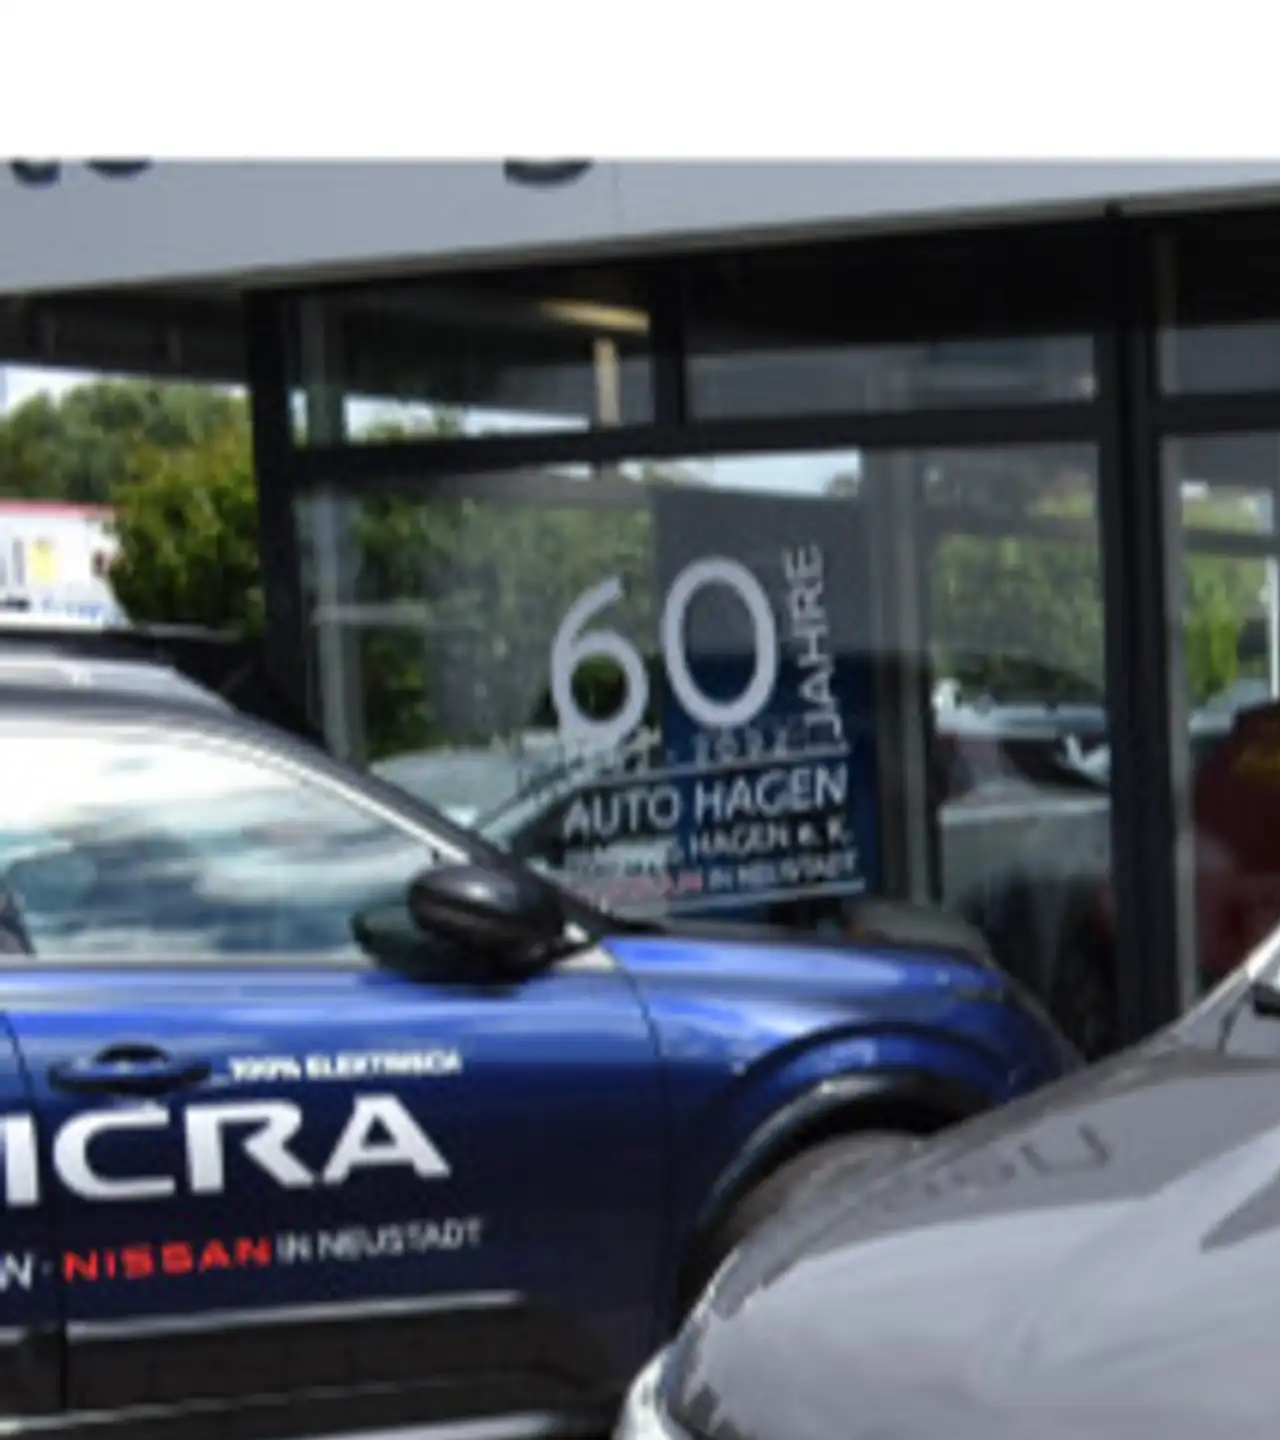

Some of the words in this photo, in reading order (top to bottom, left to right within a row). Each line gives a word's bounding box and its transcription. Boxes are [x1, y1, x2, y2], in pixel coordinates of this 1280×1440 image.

[551, 554, 778, 742] 60
[783, 543, 844, 739] JAHRE
[563, 786, 682, 840] AUTO
[694, 762, 849, 826] HAGEN
[0, 1093, 451, 1207] ICRA
[63, 1234, 272, 1283] NISSAN
[277, 1229, 312, 1265] IN
[317, 1216, 484, 1263] NEUSTADT
